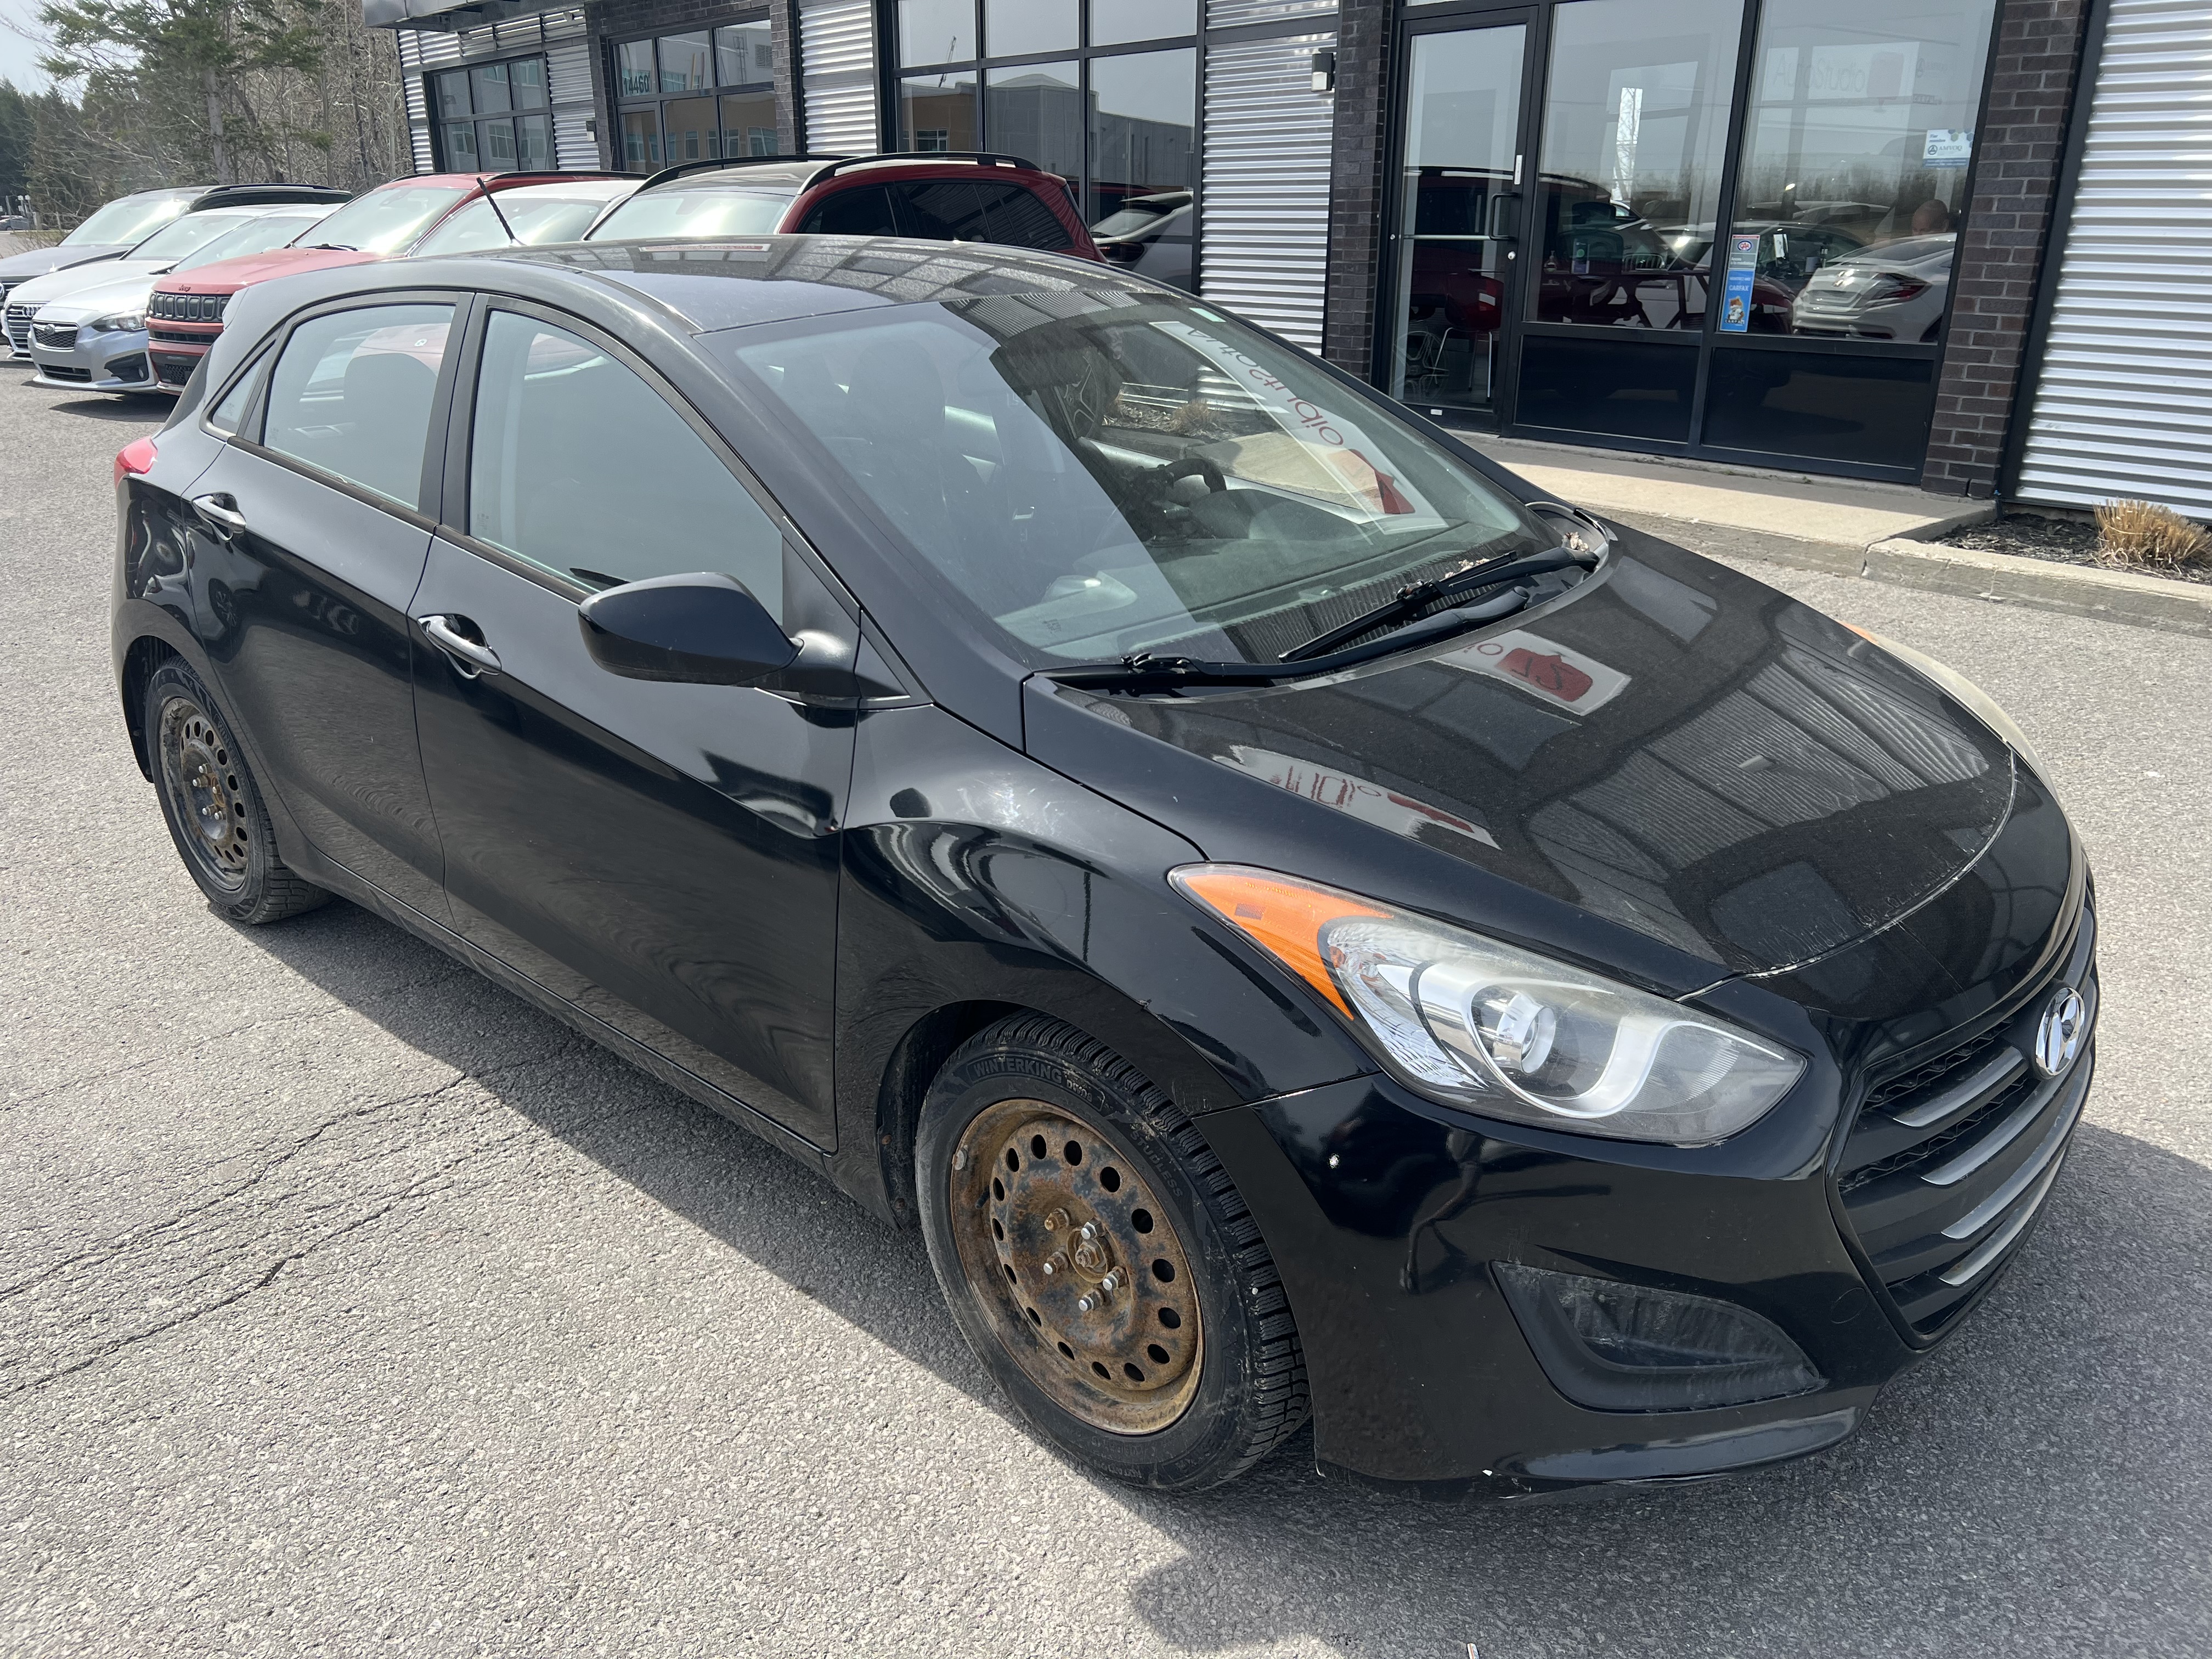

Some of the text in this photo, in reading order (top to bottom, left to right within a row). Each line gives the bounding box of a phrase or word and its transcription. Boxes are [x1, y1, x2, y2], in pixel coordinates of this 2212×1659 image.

[624, 75, 650, 95] 14460
[973, 1057, 1062, 1084] WINTERKING
[1130, 1130, 1184, 1197] STUDLESS
